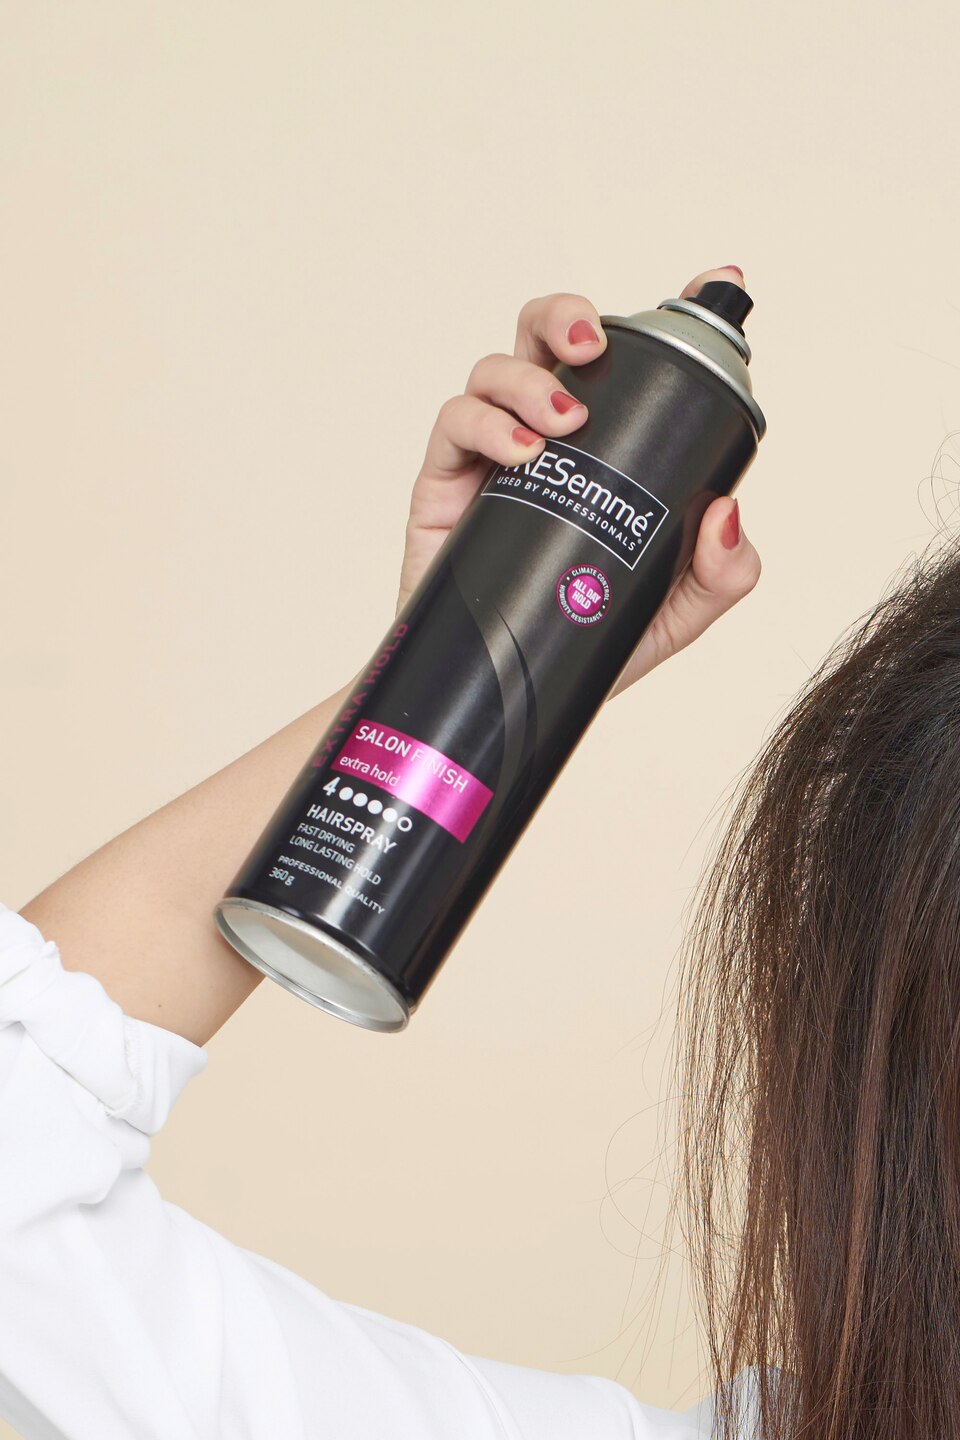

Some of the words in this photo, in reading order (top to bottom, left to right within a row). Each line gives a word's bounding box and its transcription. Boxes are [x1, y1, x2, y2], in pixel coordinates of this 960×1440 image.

[496, 476, 521, 487] USED
[524, 482, 540, 492] BY
[542, 488, 636, 552] PROFESSIONALS
[559, 584, 571, 614] HUMIDITY
[570, 611, 602, 624] RESISTANCE
[571, 567, 597, 577] CLIMATE
[597, 573, 609, 601] CONTROL
[571, 590, 591, 609] HOLD
[572, 579, 587, 594] ALL
[586, 588, 601, 604] DAY
[312, 691, 368, 768] EXTRA
[363, 623, 408, 684] HOLD
[339, 756, 370, 774] extra
[369, 764, 400, 787] hold
[355, 725, 412, 758] SALON
[410, 749, 469, 793] FINISH
[322, 776, 341, 796] 4
[297, 822, 320, 836] FAST
[318, 830, 355, 853] DRYING
[306, 804, 397, 854] HAIRSPRAY
[289, 835, 314, 850] LONG
[313, 843, 355, 869] LASTING
[353, 862, 382, 885] HOLD
[278, 855, 343, 889] PROFESSIONAL
[344, 886, 385, 915] QUALITY
